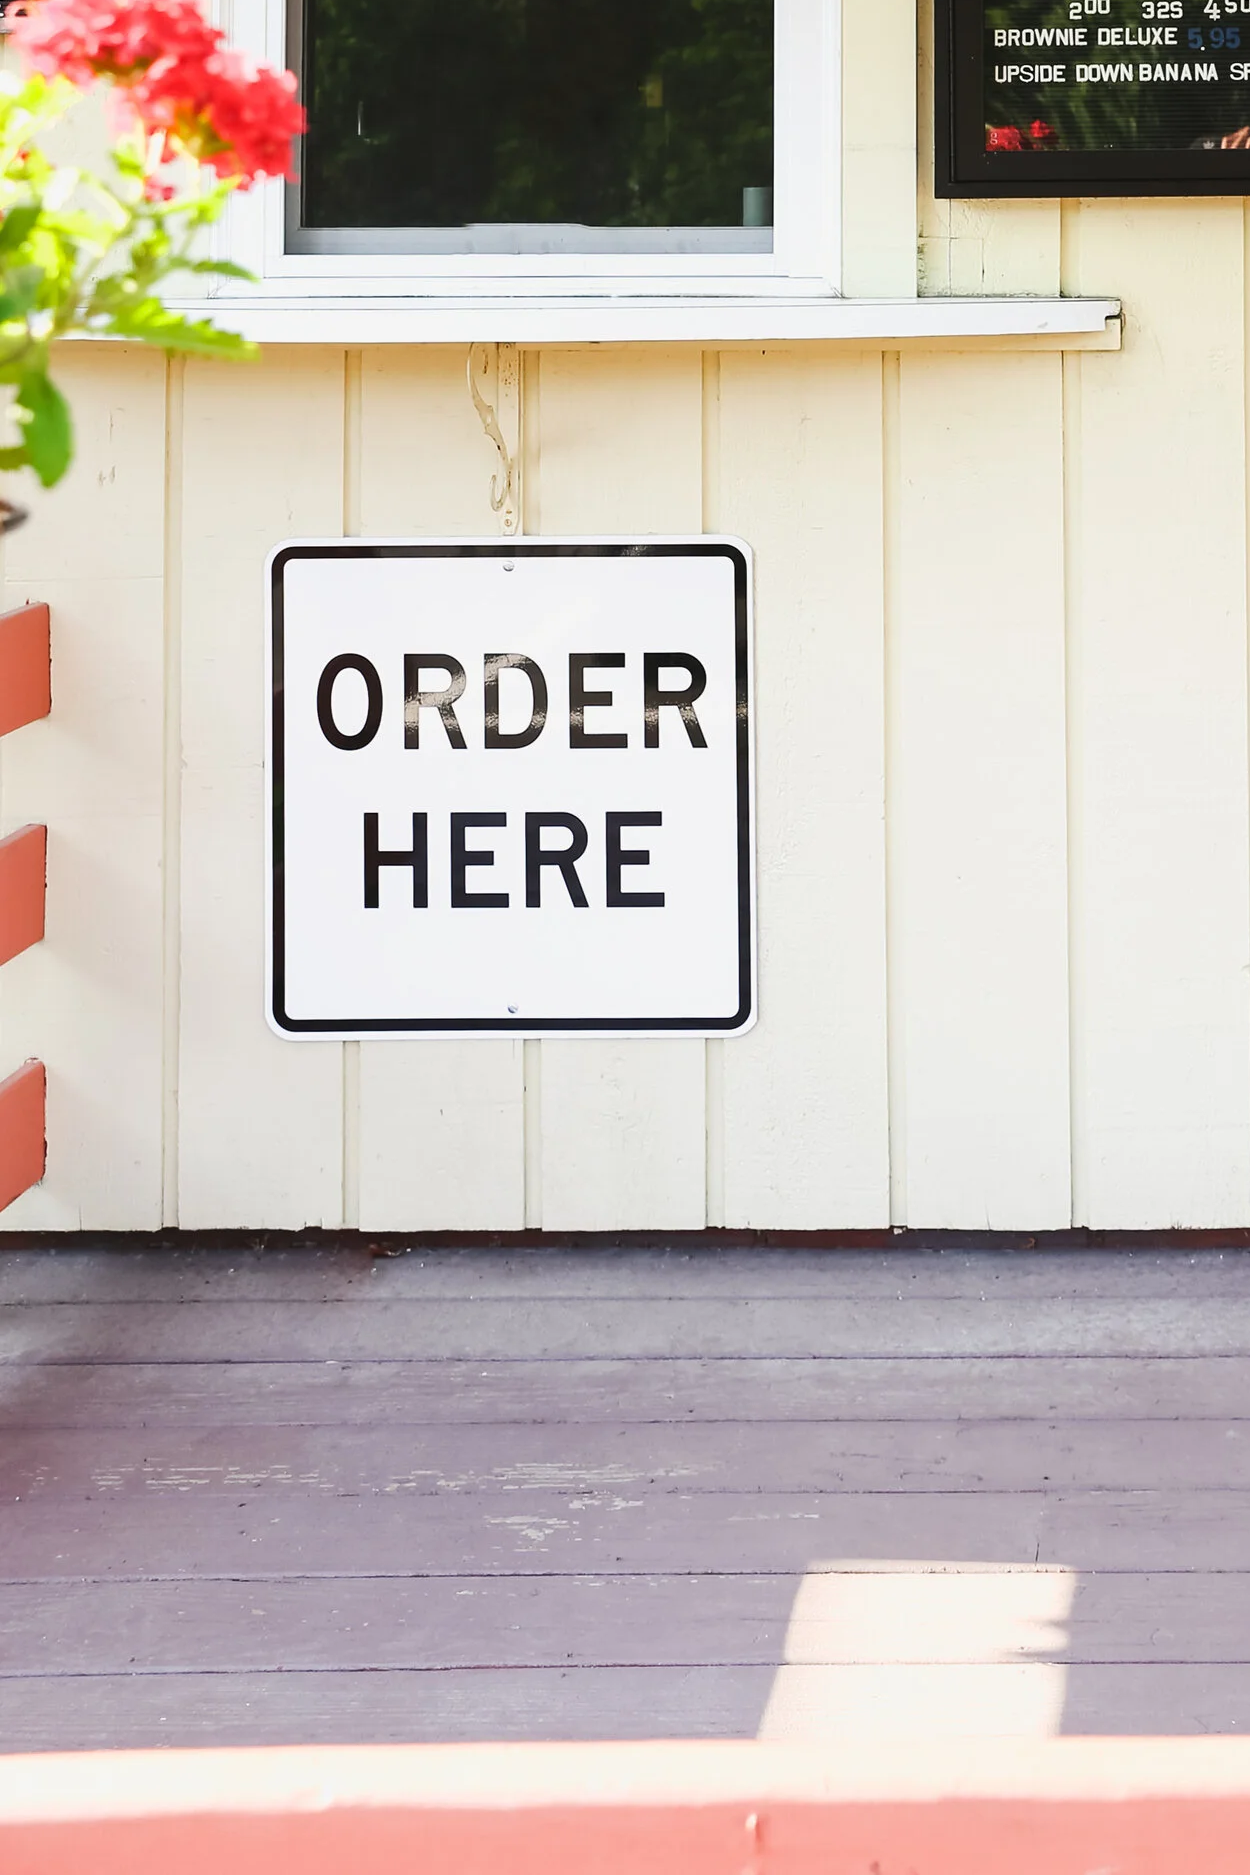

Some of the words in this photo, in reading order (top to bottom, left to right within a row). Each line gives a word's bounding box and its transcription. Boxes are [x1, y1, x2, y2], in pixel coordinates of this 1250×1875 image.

[995, 28, 1087, 47] BROWNIE
[1098, 25, 1177, 46] DELUXE
[995, 65, 1066, 83] UPSIDE
[1076, 63, 1133, 82] DOWN
[1139, 63, 1218, 81] BANANA
[316, 652, 708, 751] ORDER
[364, 811, 665, 908] HERE
